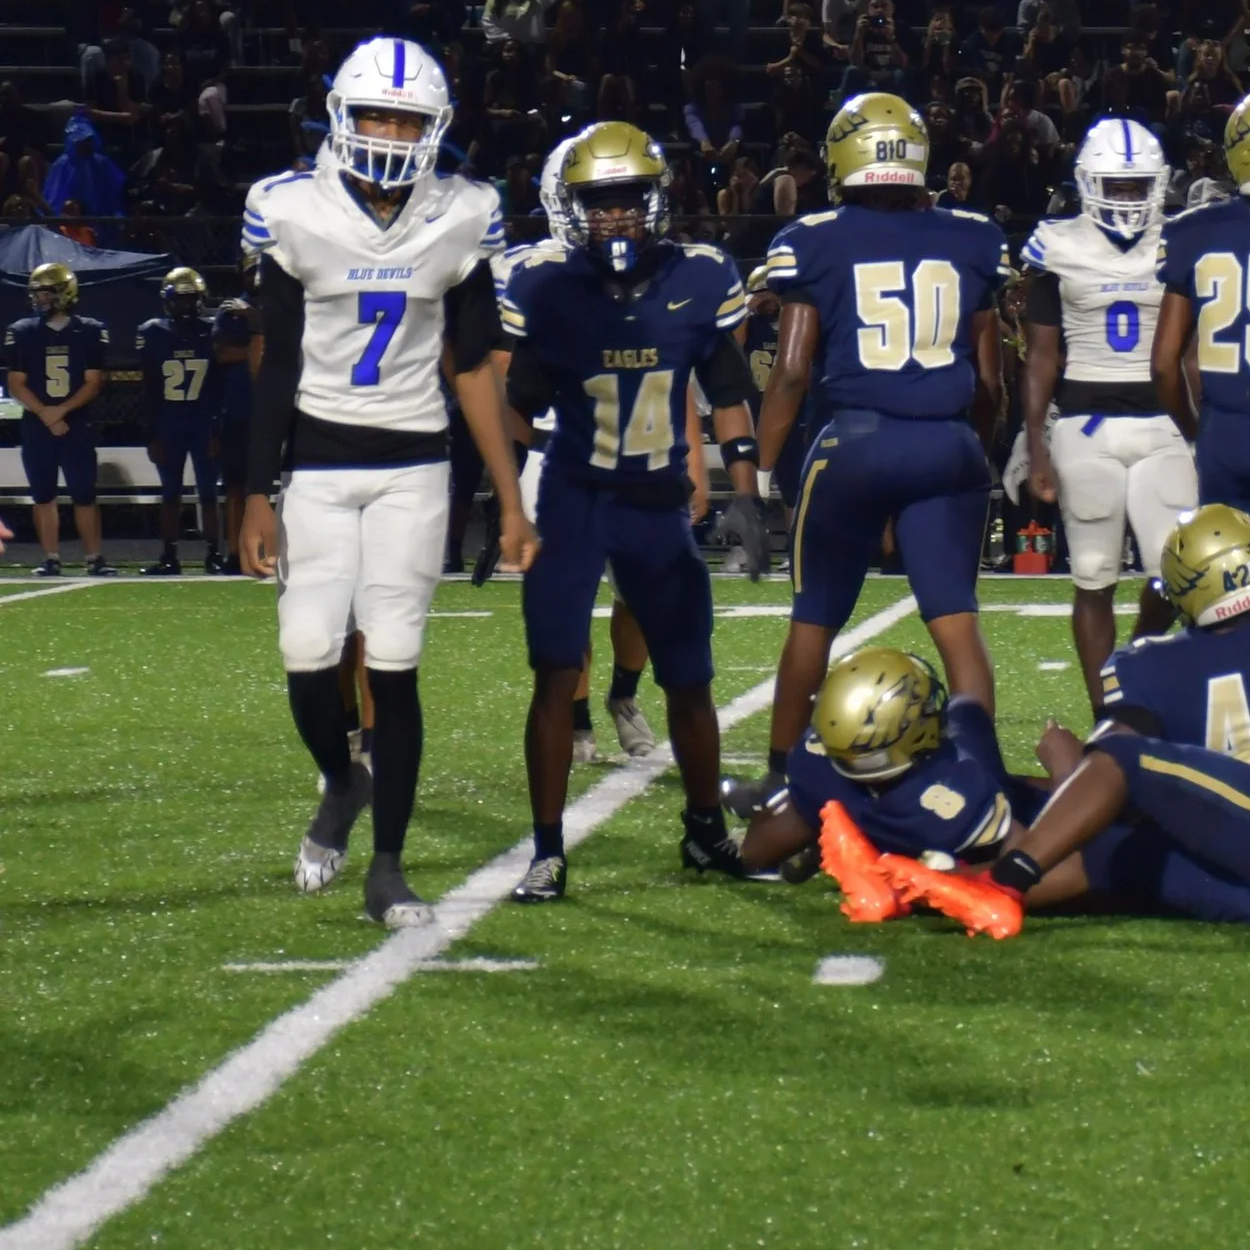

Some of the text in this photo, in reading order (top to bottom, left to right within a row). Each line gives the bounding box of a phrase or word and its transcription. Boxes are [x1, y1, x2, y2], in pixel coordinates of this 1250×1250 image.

[865, 171, 914, 183] Riddell
[347, 267, 413, 280] BLUE DEVILS
[853, 259, 961, 371] 50
[1106, 300, 1140, 353] 0
[351, 291, 407, 386] 7
[602, 348, 658, 368] EAGLES
[45, 354, 71, 398] 5
[161, 358, 210, 401] 27
[581, 369, 675, 471] 14
